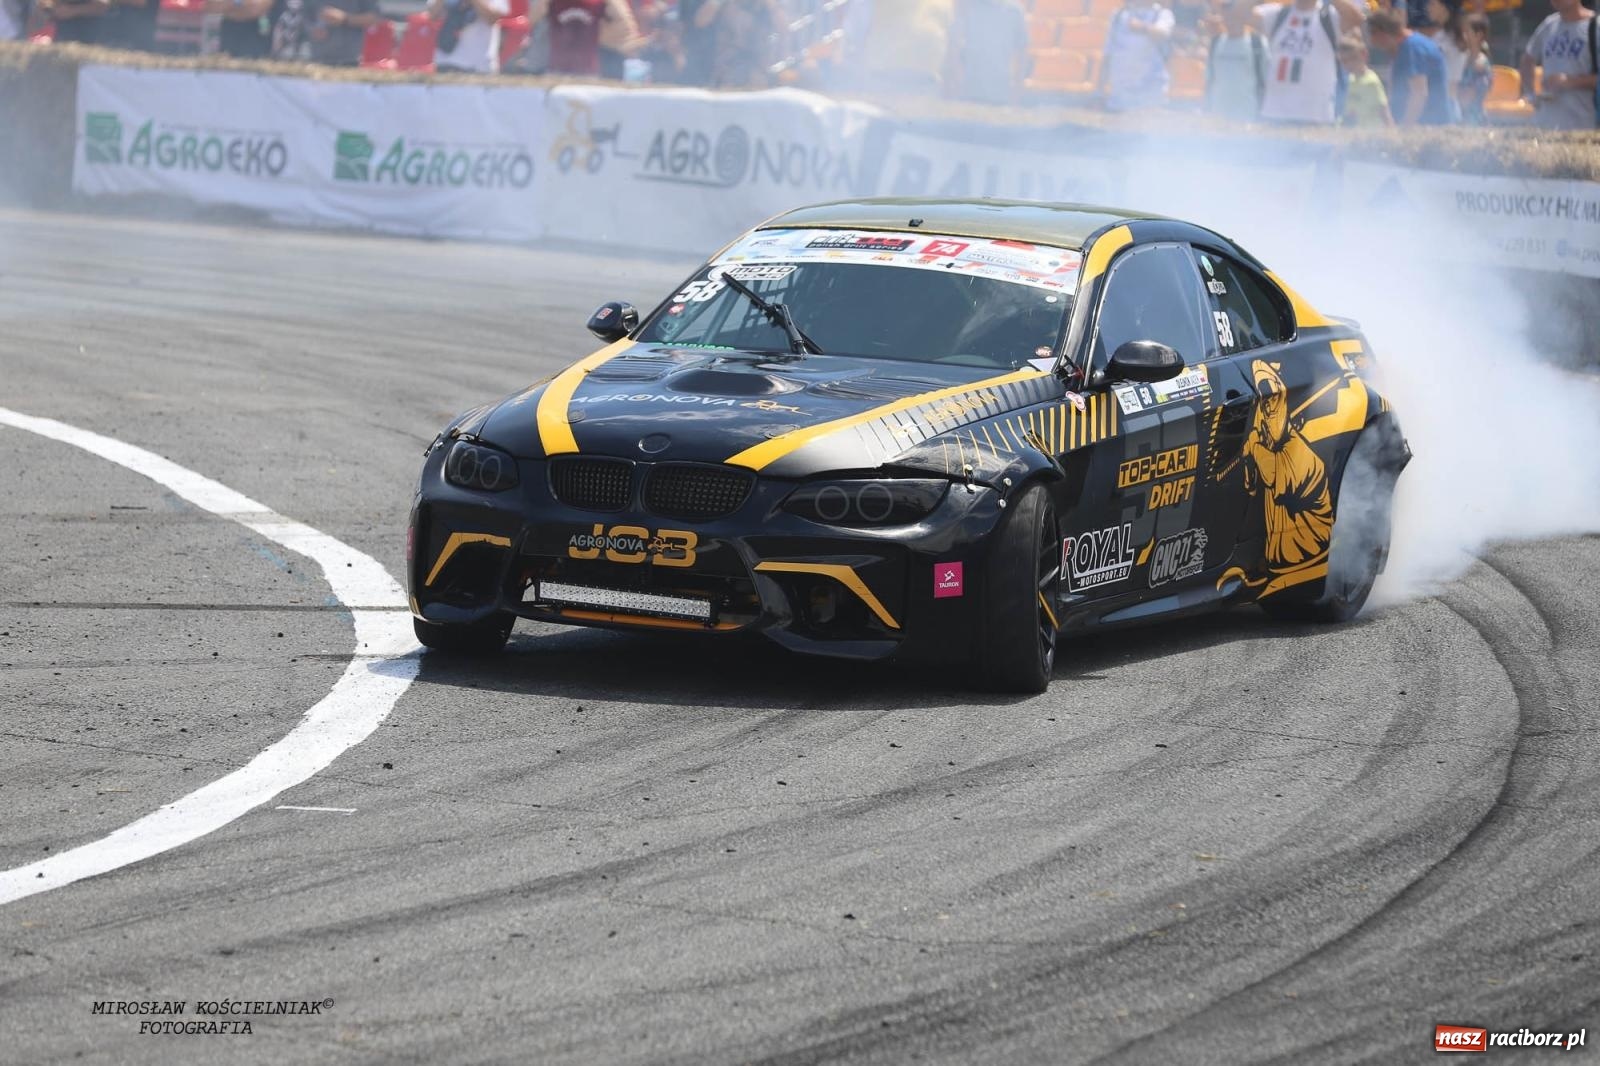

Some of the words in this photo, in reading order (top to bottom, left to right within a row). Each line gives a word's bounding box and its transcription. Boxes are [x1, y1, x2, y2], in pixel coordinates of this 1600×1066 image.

[127, 118, 288, 177] AGROEKO
[373, 134, 535, 189] AGROEKO
[643, 124, 858, 191] AGRONOVA
[673, 280, 727, 303] 58
[1213, 311, 1234, 347] 58
[1119, 447, 1189, 485] TOP-CAR
[1149, 475, 1195, 511] DRIFT
[569, 534, 645, 551] AGRONOVA
[1060, 522, 1135, 580] ROYAL
